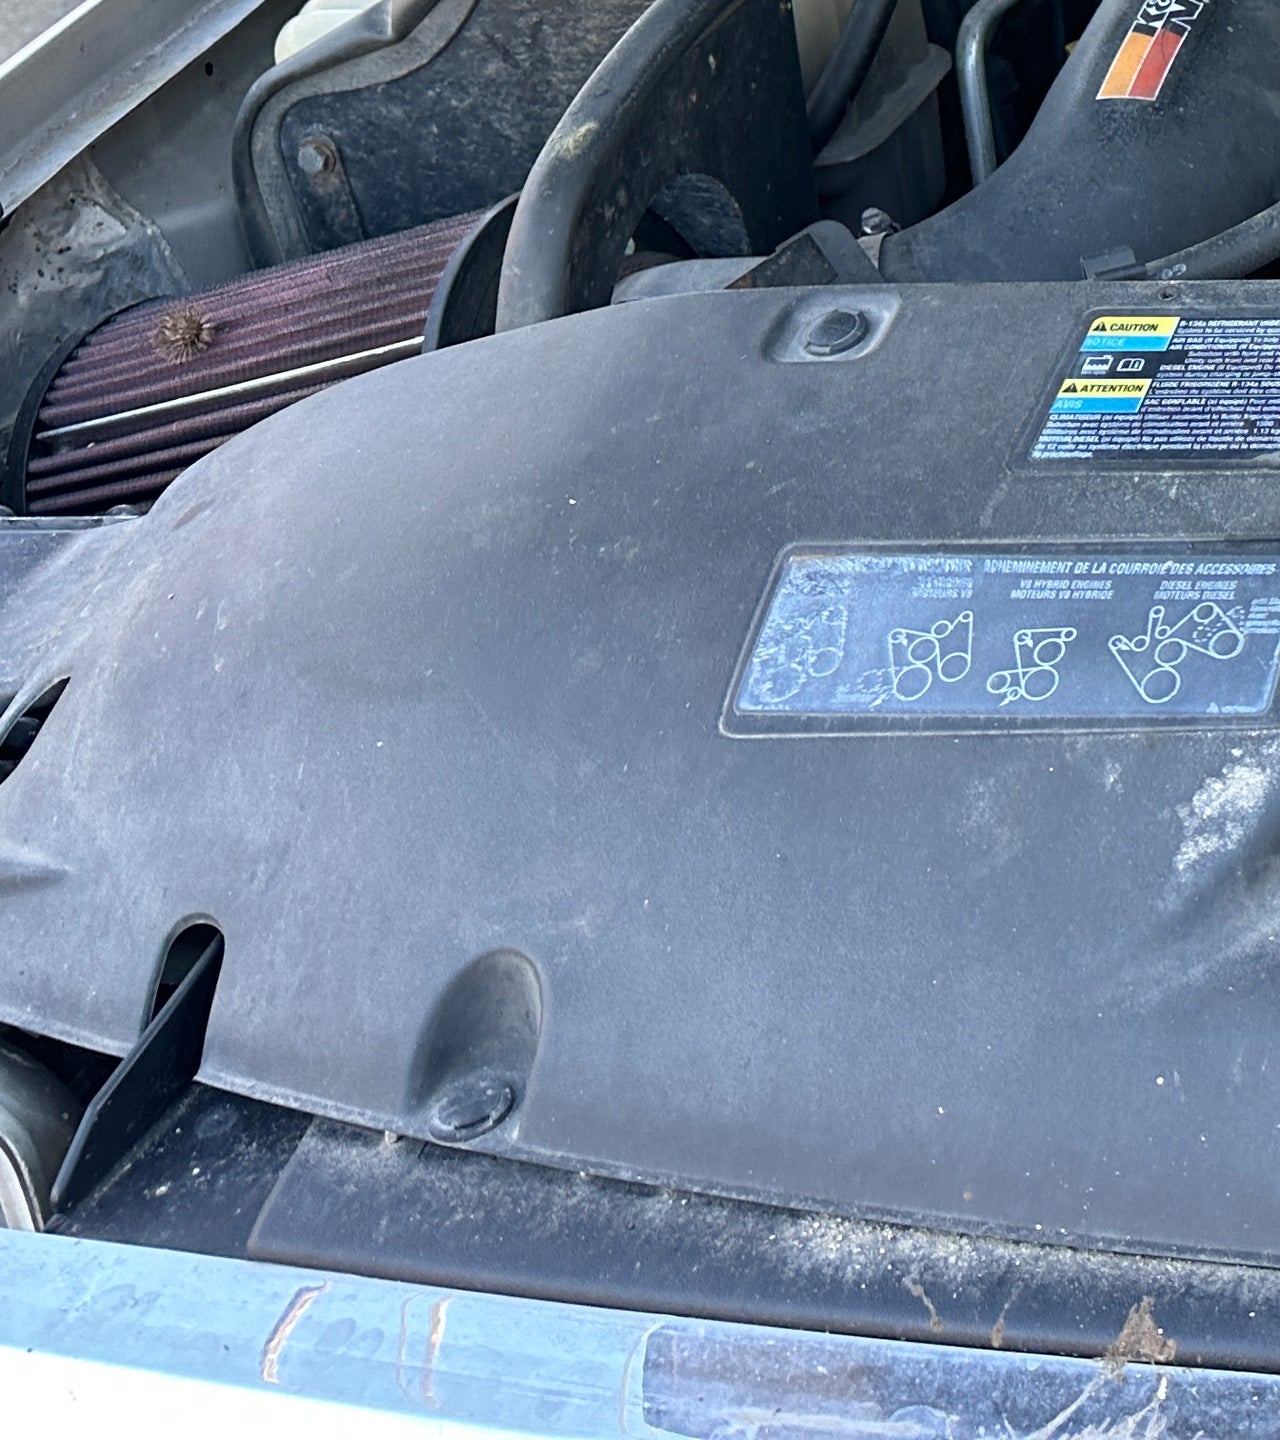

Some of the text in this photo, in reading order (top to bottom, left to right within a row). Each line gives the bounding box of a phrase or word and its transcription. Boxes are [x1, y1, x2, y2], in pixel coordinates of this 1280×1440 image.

[1109, 322, 1159, 333] CAUTION
[1080, 383, 1143, 393] ATTENTION
[1054, 400, 1083, 410] AVIS
[1073, 561, 1090, 574] DE
[1091, 562, 1107, 574] LA
[1171, 562, 1195, 575] DES
[1034, 579, 1069, 589] HYBRID
[1071, 580, 1112, 590] ENGINES
[1160, 580, 1193, 590] DIESEL
[1072, 590, 1114, 599] HYBRIDE
